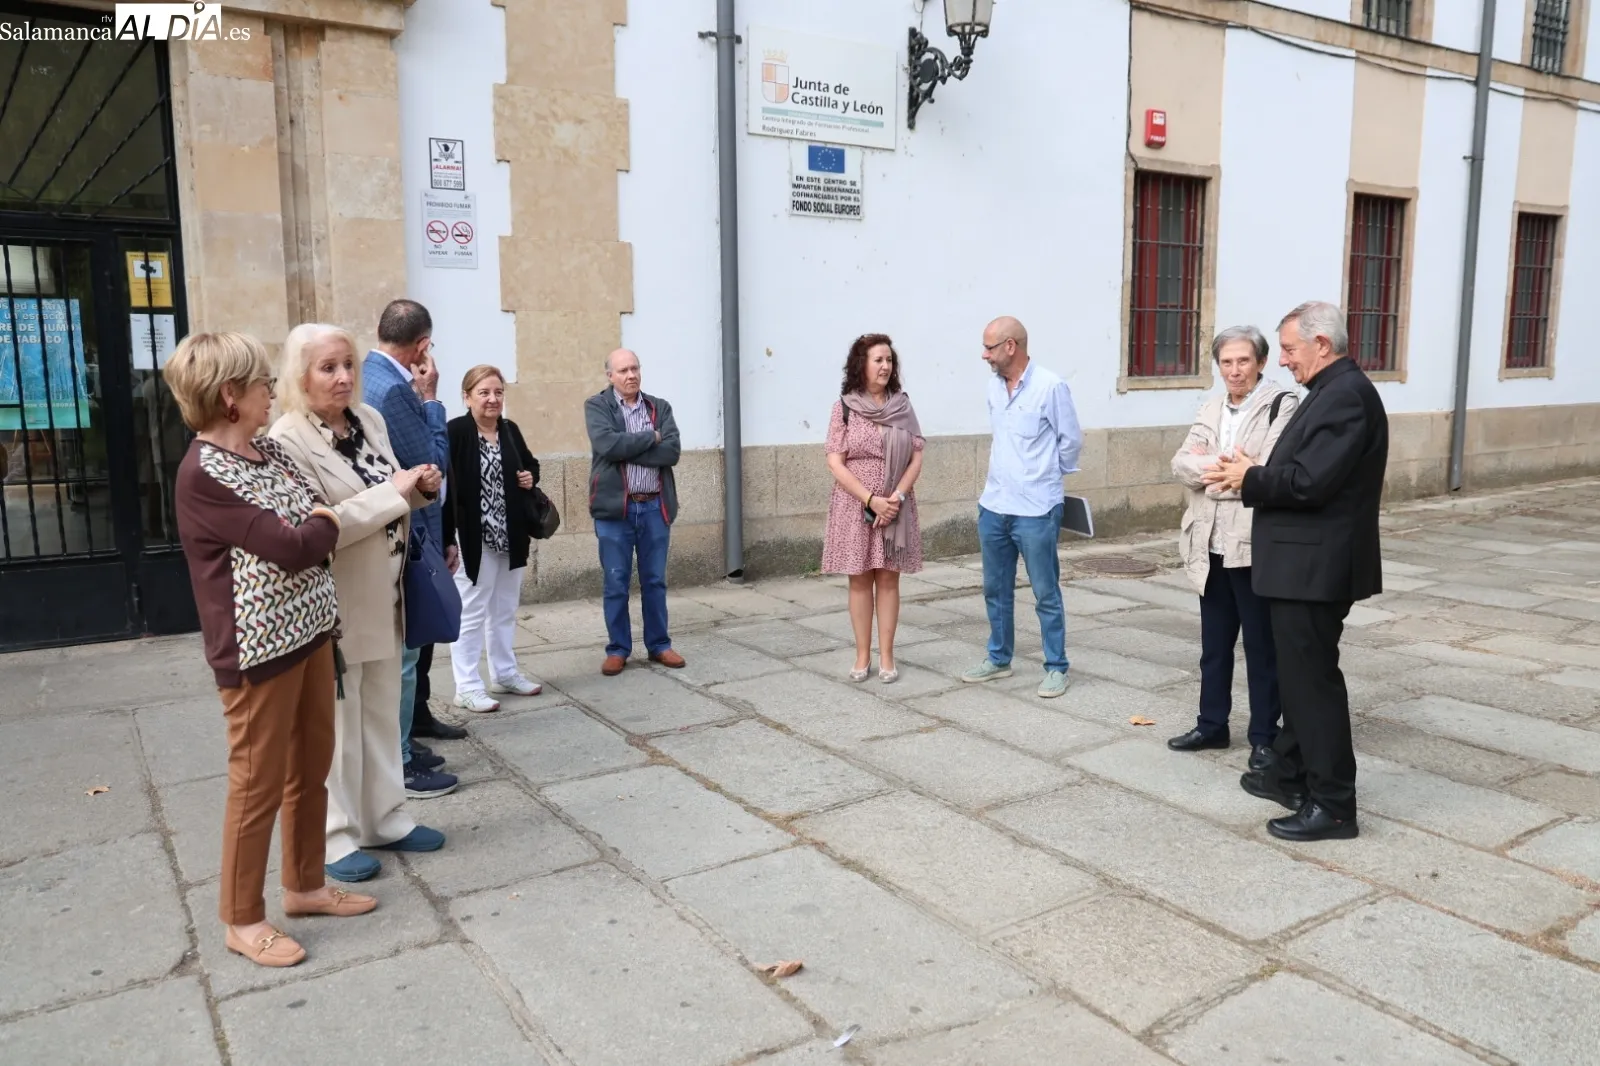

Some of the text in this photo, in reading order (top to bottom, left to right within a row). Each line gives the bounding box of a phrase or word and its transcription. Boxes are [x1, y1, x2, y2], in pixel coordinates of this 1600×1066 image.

[792, 76, 850, 96] Junta de
[791, 91, 884, 116] Castilla y León
[824, 178, 847, 186] CENTRO
[792, 183, 860, 195] IMPARTEN ENSEÑANZAS
[792, 191, 838, 201] COFINANCIADAS
[792, 200, 860, 216] FONDO SOCIAL EUROPEO
[18, 323, 36, 332] DE
